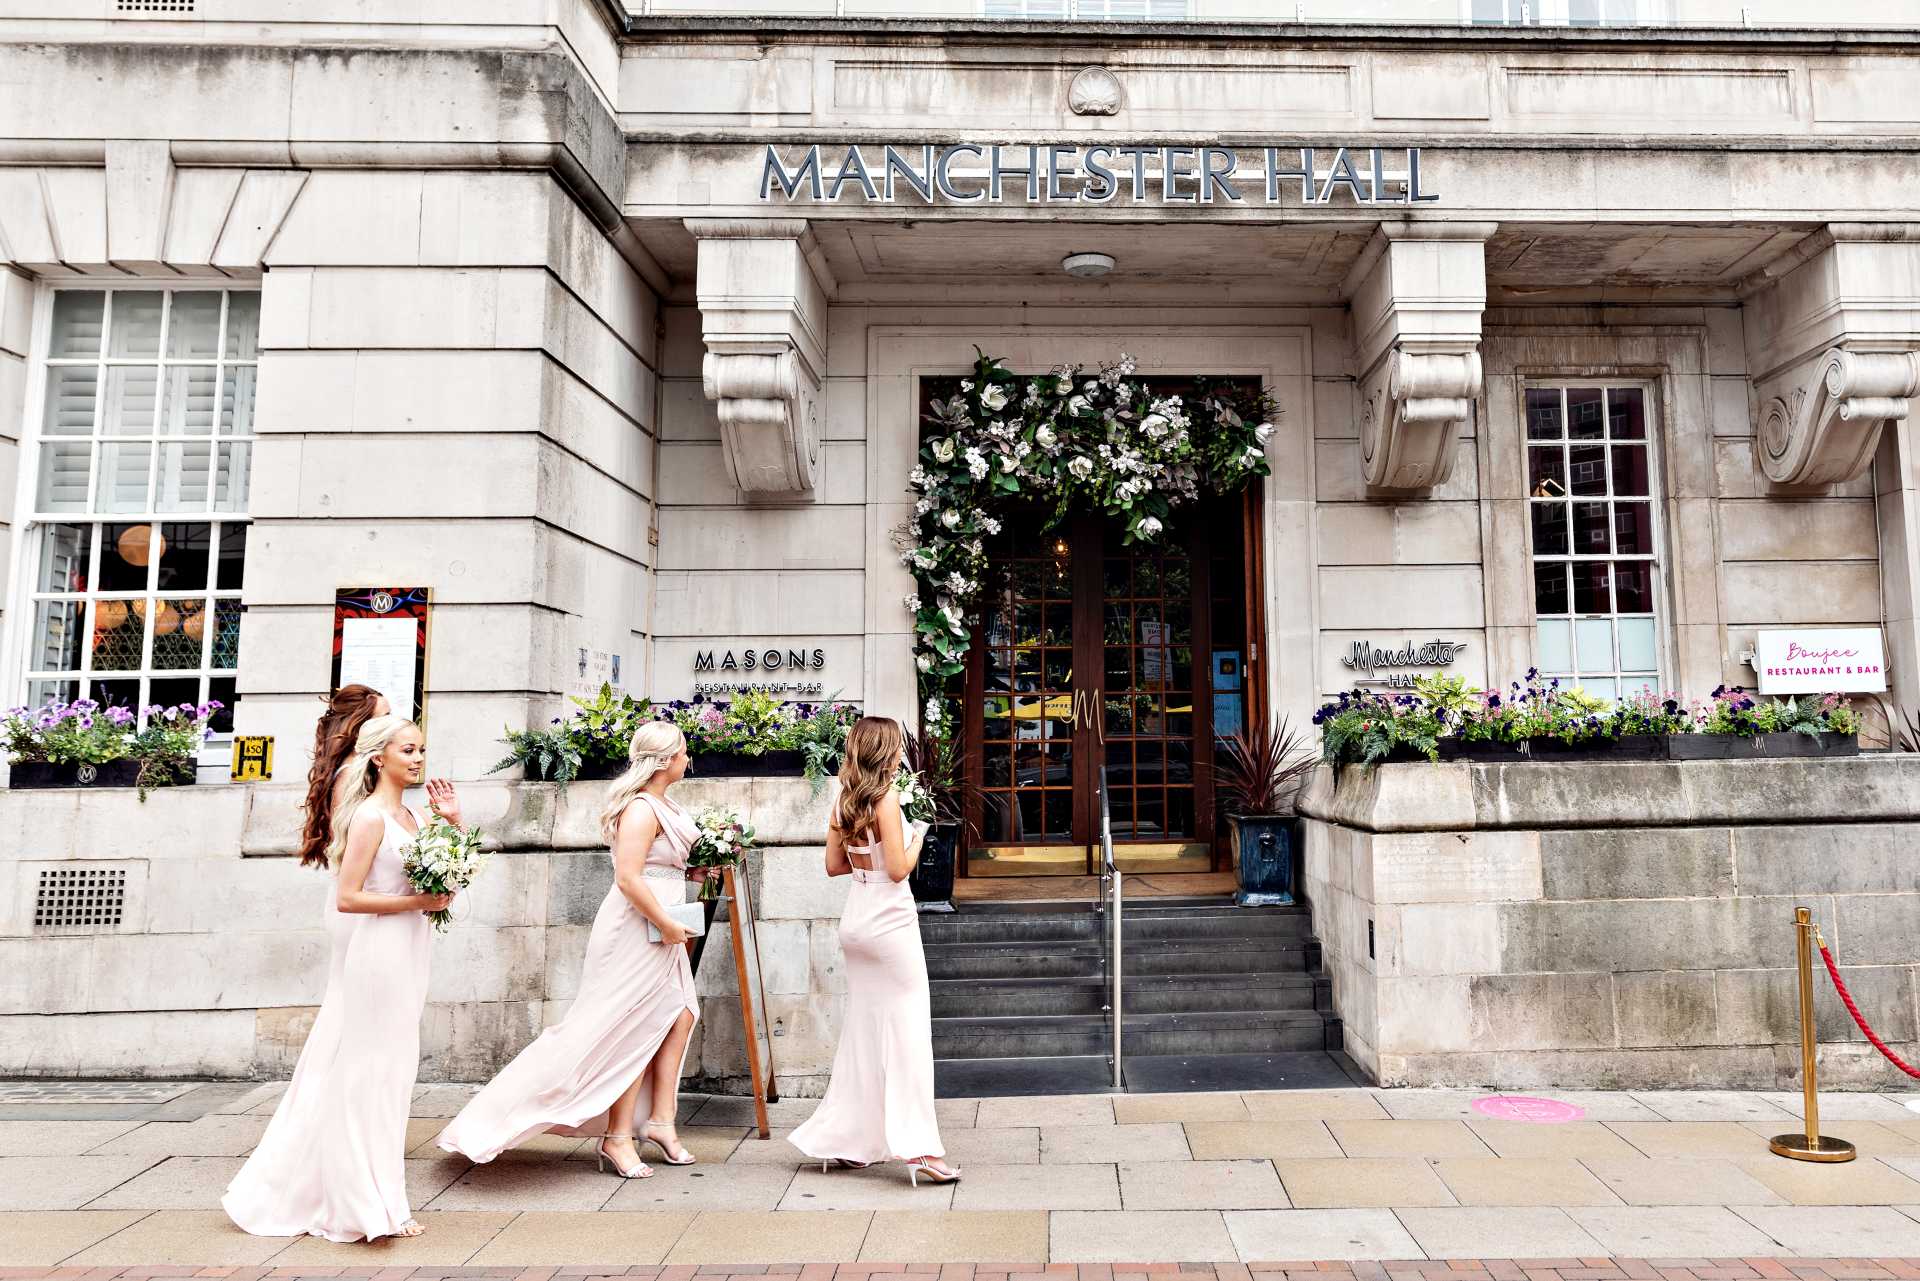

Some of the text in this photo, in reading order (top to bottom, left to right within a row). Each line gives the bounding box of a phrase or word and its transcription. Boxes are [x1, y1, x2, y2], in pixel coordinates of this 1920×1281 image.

[760, 144, 1440, 204] MANCHESTER HALL
[694, 648, 825, 670] MASONS
[1342, 638, 1467, 678] Manchester
[1786, 642, 1859, 664] Boujee
[1388, 673, 1423, 688] HAL
[1767, 665, 1880, 676] RESTAURANT & BAR
[695, 682, 823, 693] RESTAURANT BAR
